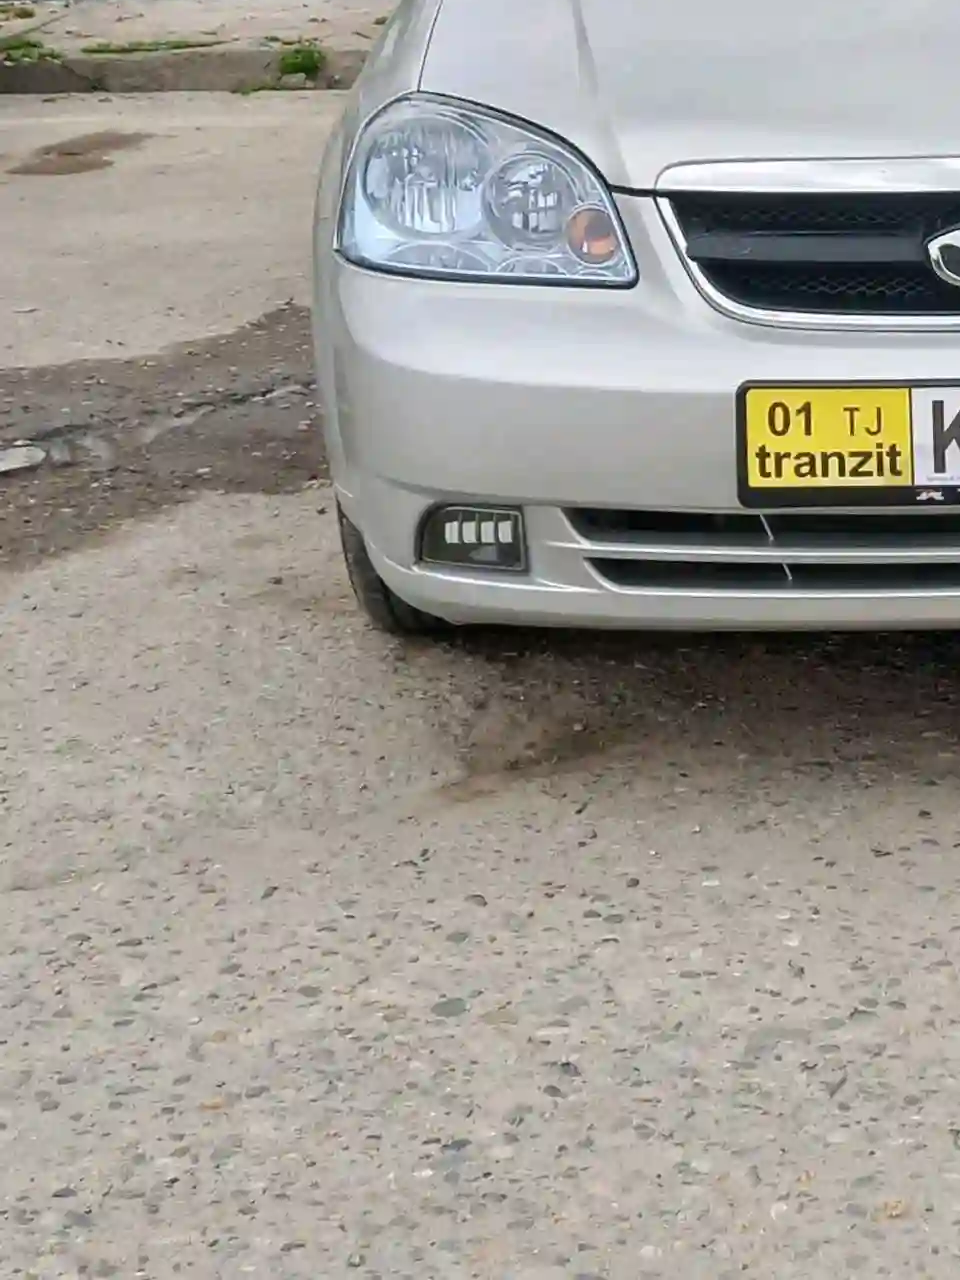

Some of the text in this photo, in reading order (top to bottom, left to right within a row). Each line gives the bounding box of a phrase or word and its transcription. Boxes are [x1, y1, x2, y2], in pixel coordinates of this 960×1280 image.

[768, 401, 882, 436] 01 TJ
[755, 442, 902, 478] tranzit
